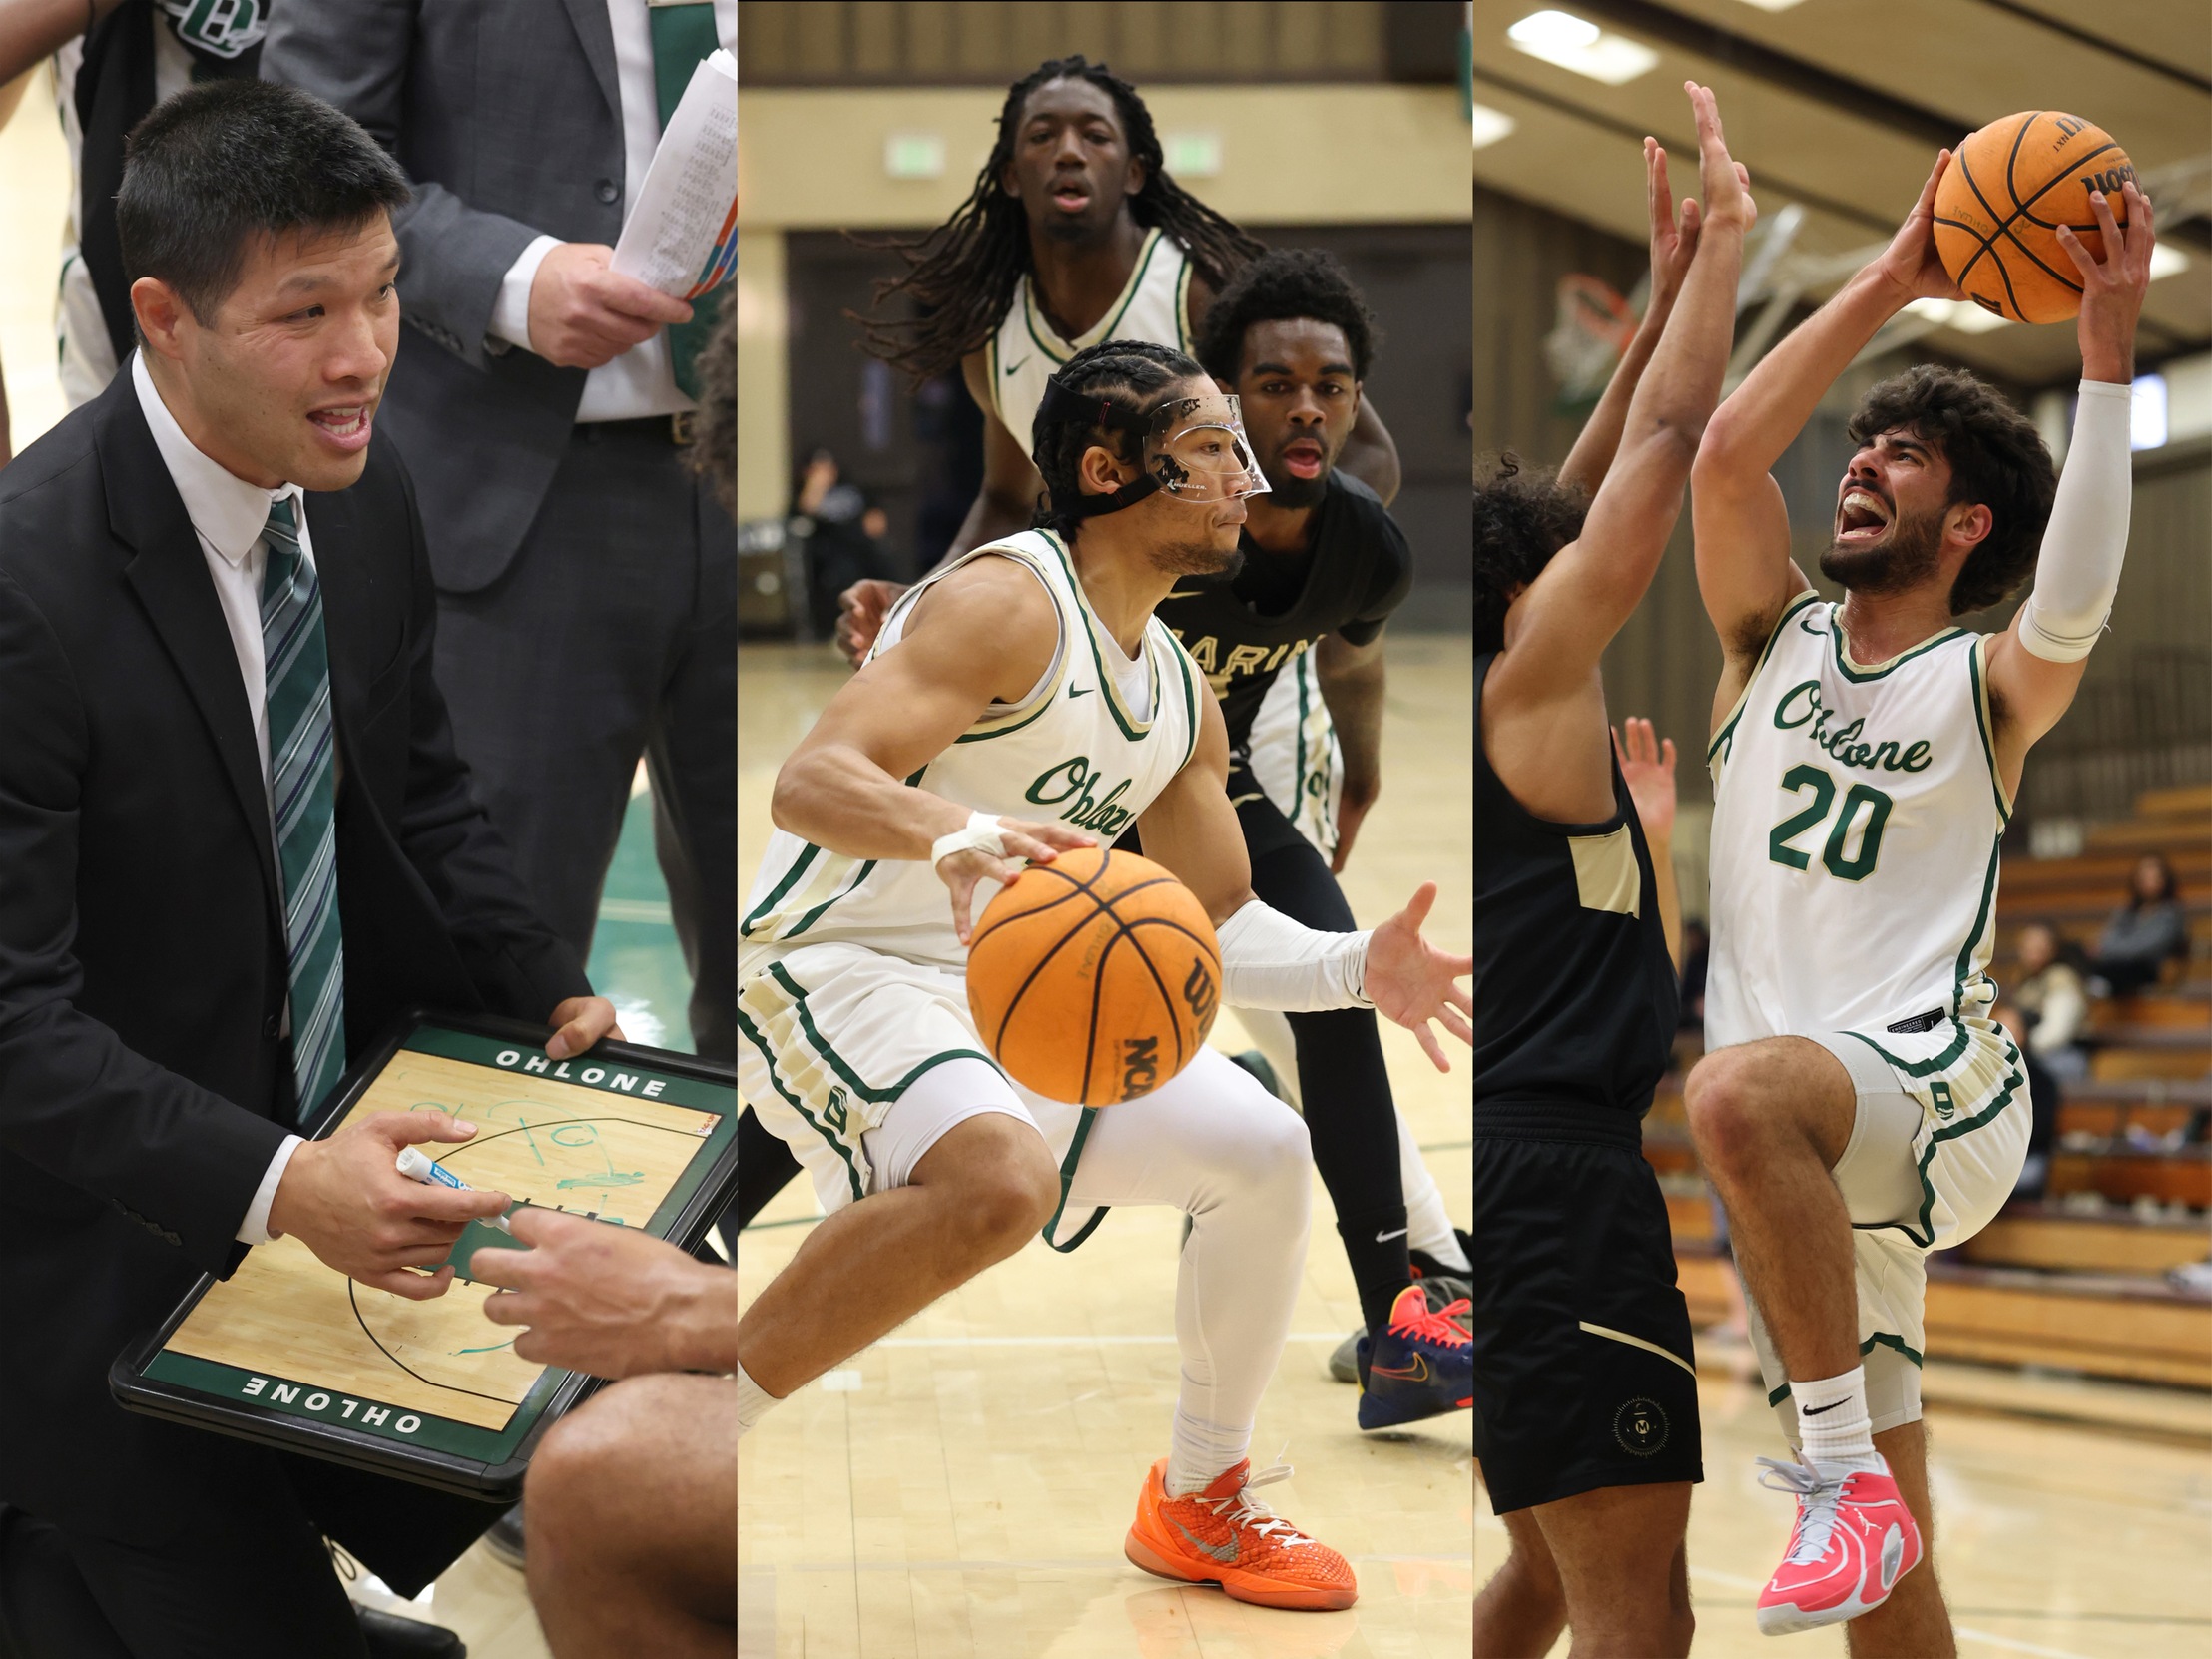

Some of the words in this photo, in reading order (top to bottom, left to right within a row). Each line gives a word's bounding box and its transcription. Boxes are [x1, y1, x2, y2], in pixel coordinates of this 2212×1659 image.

[1773, 679, 1933, 773] Ohlone
[1768, 761, 1896, 884] 20
[496, 1050, 667, 1097] OHLONE
[241, 1377, 422, 1434] OHLONE
